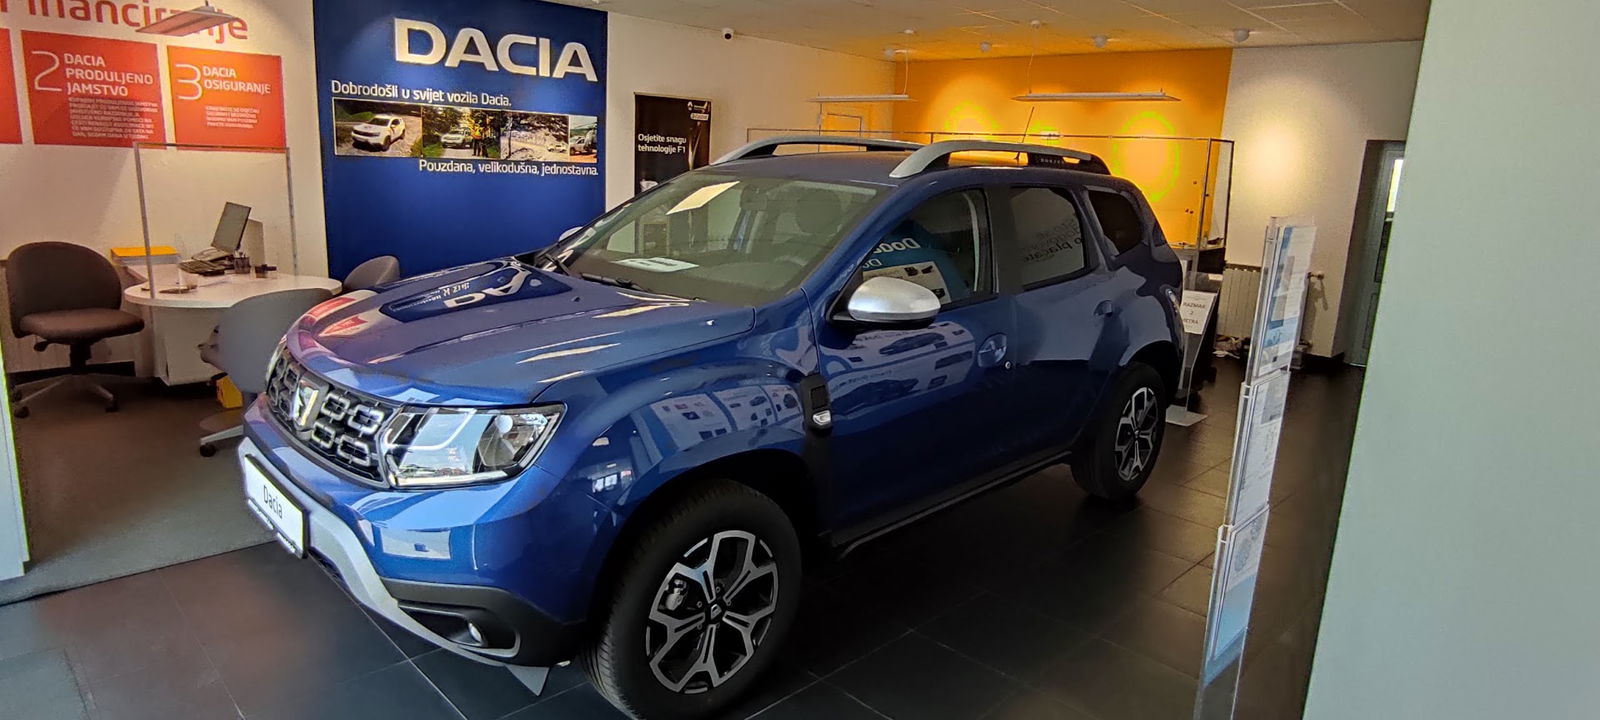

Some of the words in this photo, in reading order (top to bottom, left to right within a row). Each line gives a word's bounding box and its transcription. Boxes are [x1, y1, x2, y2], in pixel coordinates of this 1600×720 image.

[394, 17, 598, 82] DACIA
[63, 53, 106, 68] DACIA
[31, 50, 63, 92] 2
[65, 67, 154, 86] PRODULJENO
[201, 65, 237, 79] DACIA
[66, 82, 129, 97] JAMSTVO
[175, 63, 203, 101] 3
[203, 79, 271, 95] OSIGURANJE
[331, 80, 399, 98] Dobrodošli
[402, 88, 411, 99] u
[413, 88, 445, 103] svijet
[447, 91, 479, 104] vozila
[481, 93, 512, 107] Dacia.
[638, 133, 665, 143] Osjetite
[666, 136, 687, 145] snagu
[637, 144, 677, 155] tehnologije
[677, 146, 686, 154] F1
[419, 159, 476, 174] Pouzdana,
[478, 161, 540, 175] velikodušna,
[541, 163, 599, 177] jednostavna.
[263, 485, 283, 519] Dacia
